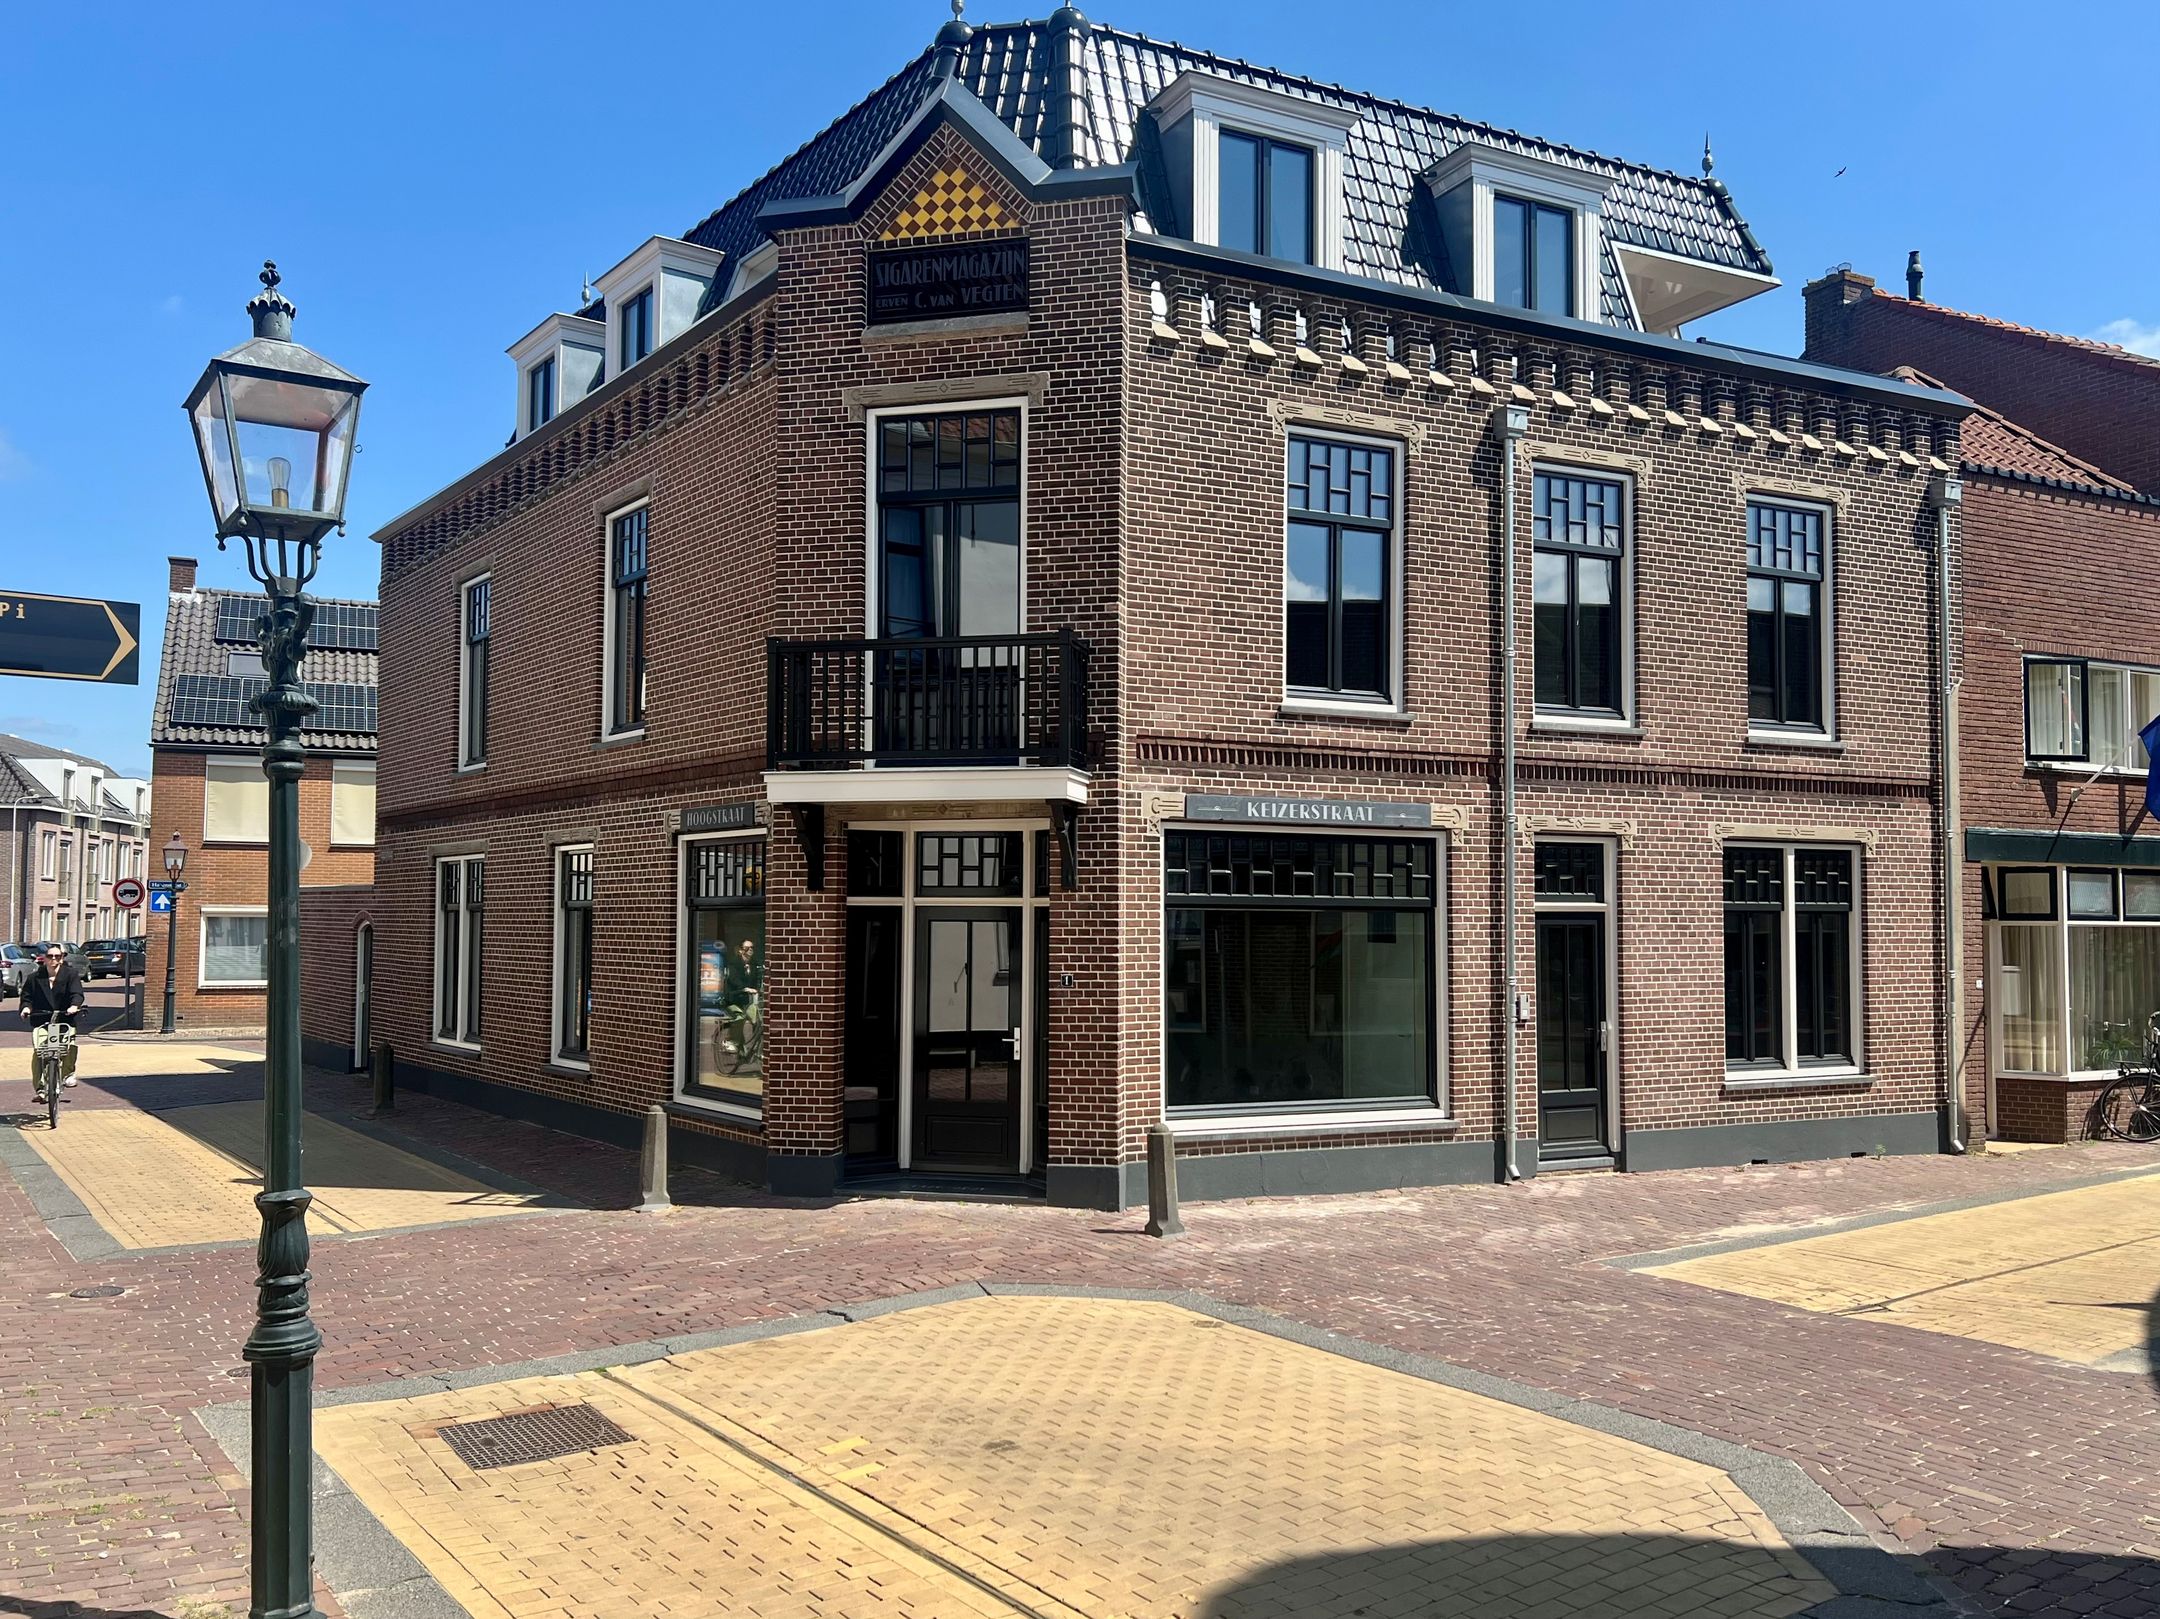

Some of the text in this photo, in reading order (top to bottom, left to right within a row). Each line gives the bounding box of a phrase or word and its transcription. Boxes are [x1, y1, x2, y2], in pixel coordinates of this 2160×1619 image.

[930, 294, 954, 308] VAN
[960, 283, 1025, 305] VEGTEN
[687, 807, 745, 827] HOOGSTRAAT
[1247, 801, 1376, 822] KEIZERSTRAAT
